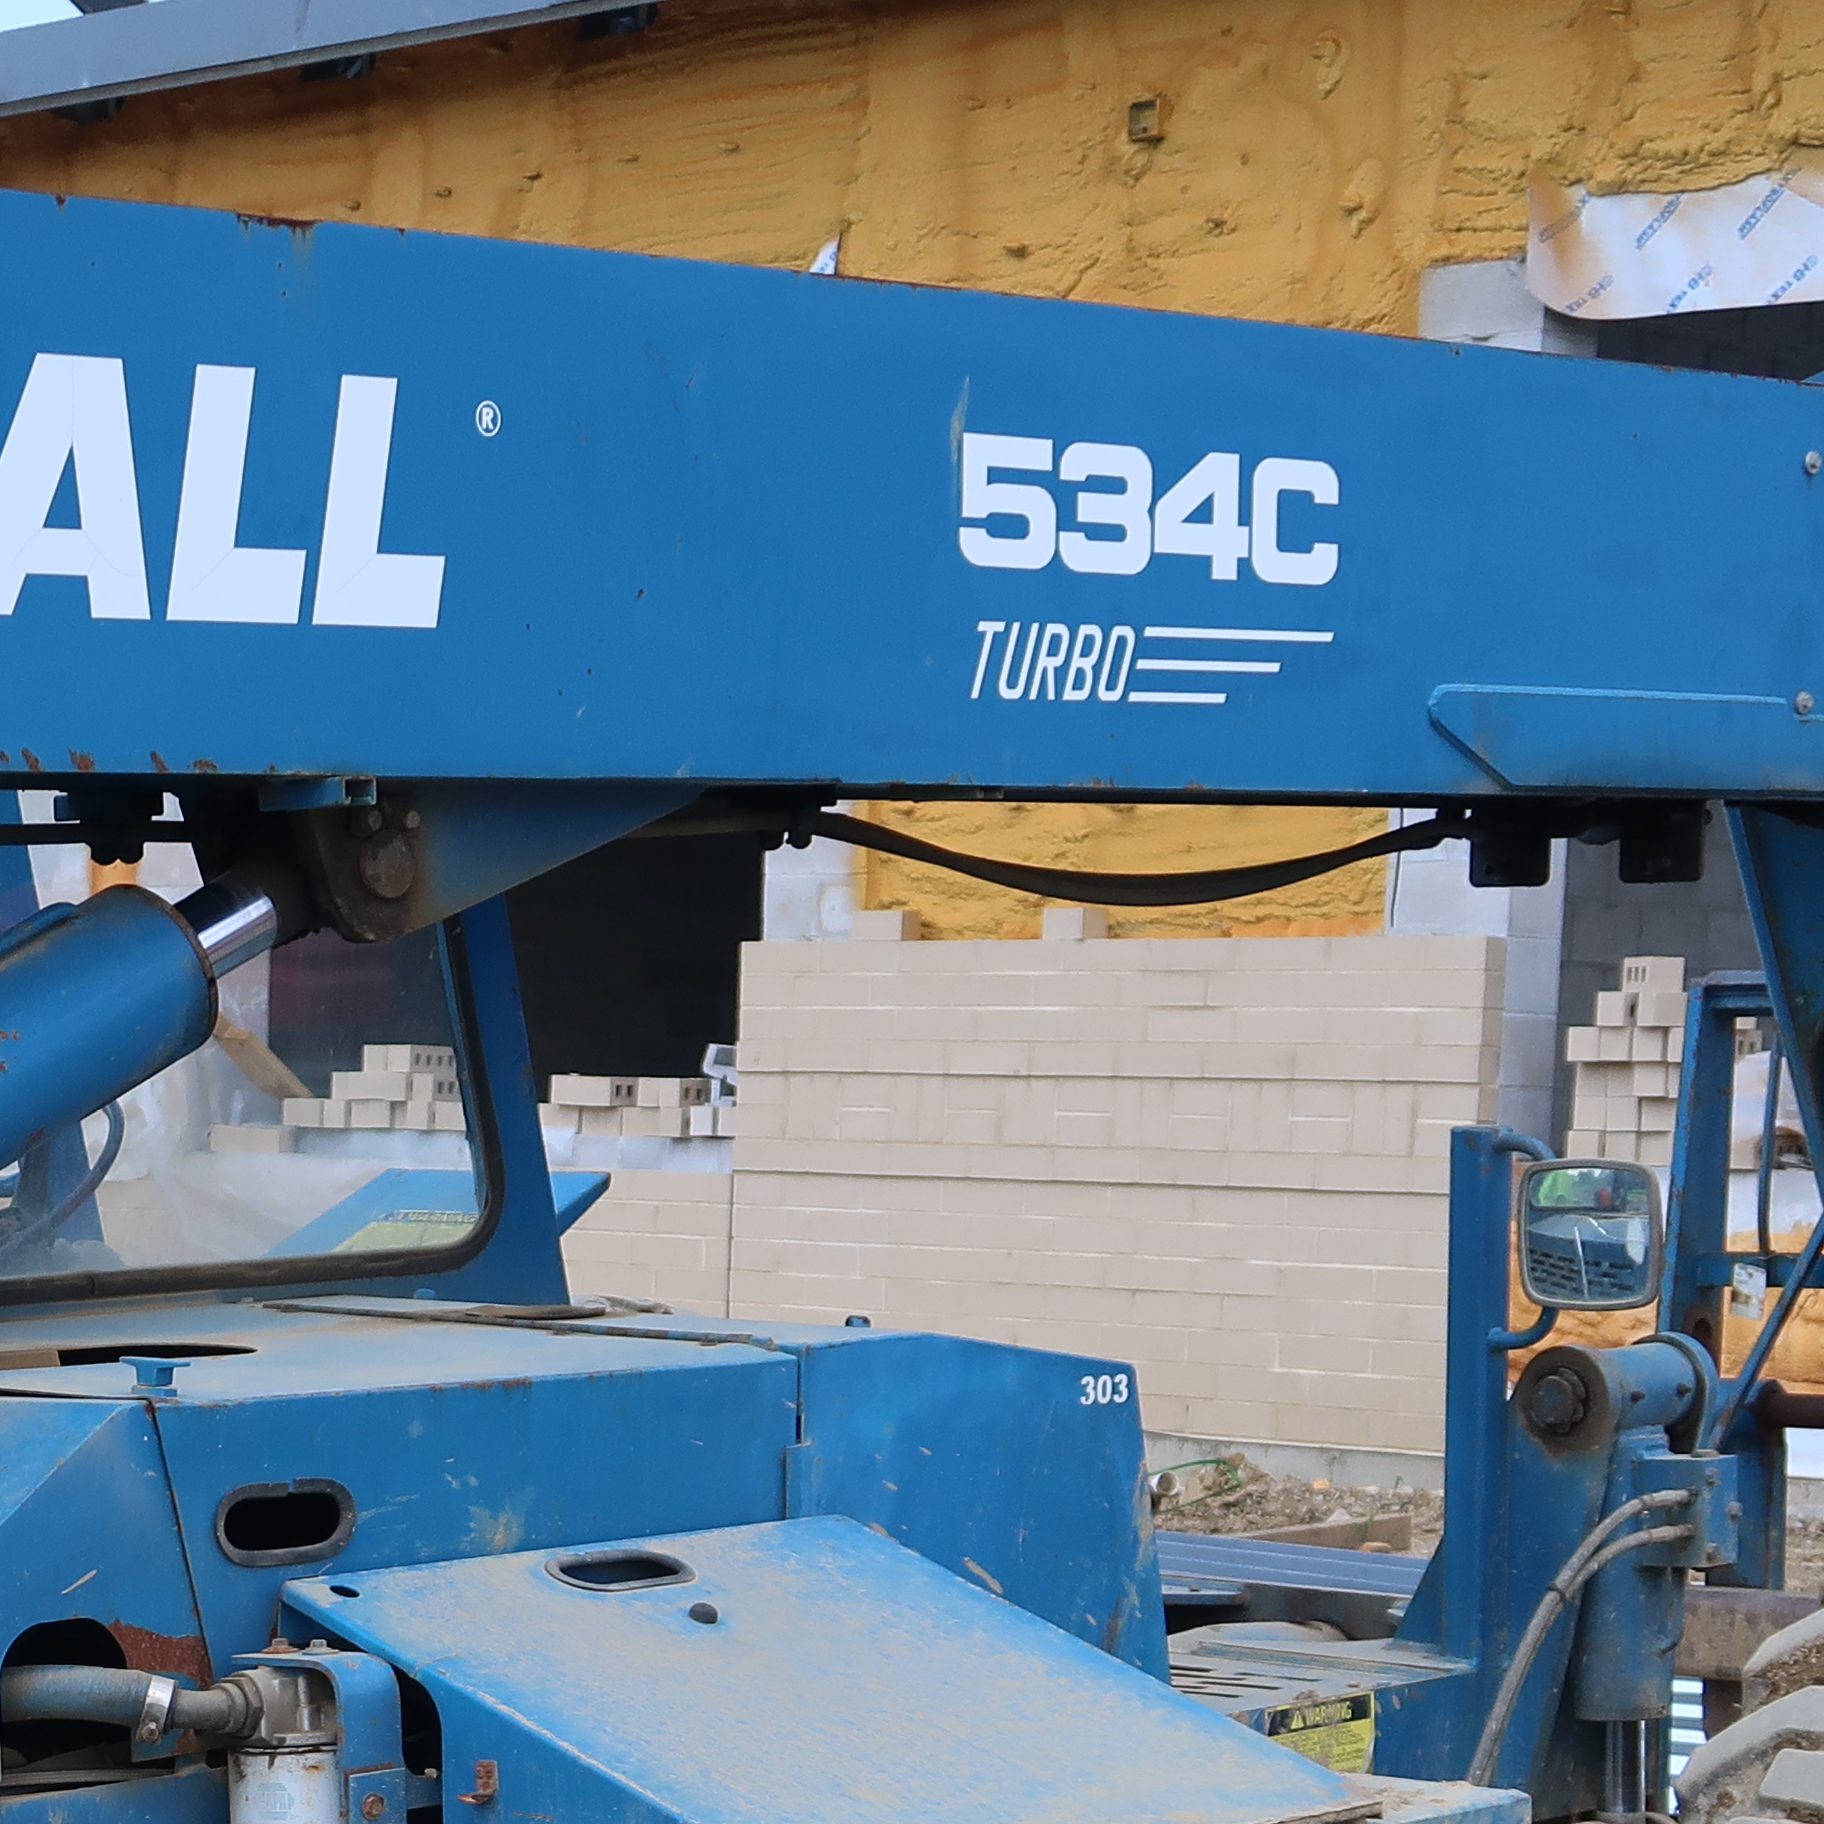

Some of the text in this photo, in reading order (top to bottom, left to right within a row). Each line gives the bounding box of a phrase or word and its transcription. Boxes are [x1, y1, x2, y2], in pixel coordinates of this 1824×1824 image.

[958, 432, 1339, 586] 534C
[970, 620, 1137, 703] TURBO
[1080, 1373, 1129, 1405] 303
